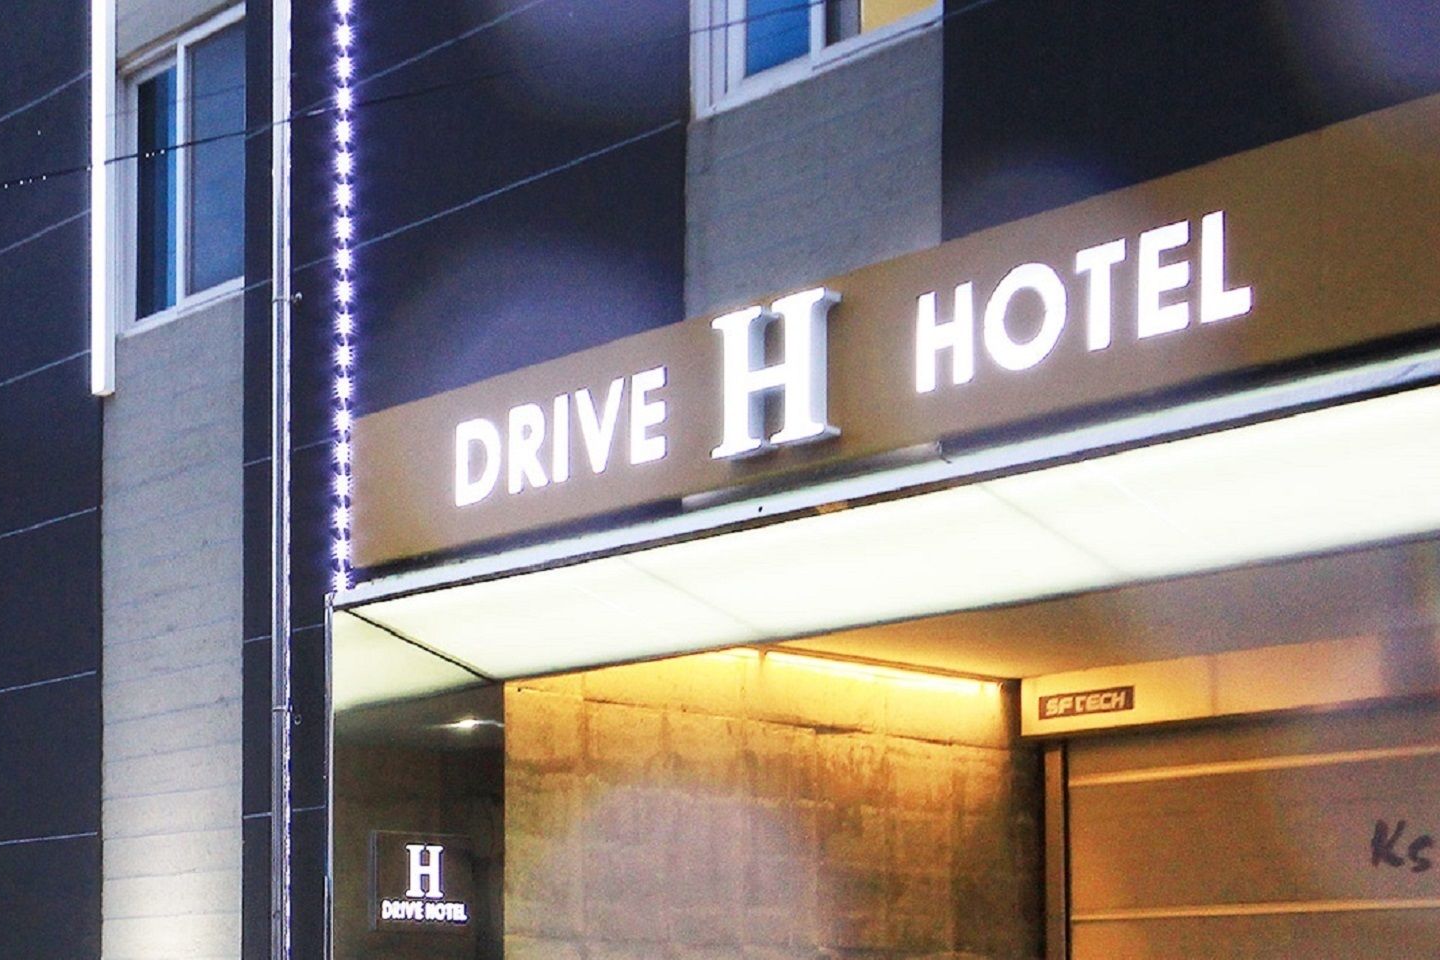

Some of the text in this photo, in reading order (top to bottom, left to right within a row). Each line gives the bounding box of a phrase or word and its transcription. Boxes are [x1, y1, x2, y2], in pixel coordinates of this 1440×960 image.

[455, 211, 1252, 507] DRIVE H HOTEL
[405, 844, 444, 898] H
[381, 900, 467, 921] DRIVE HOTEL
